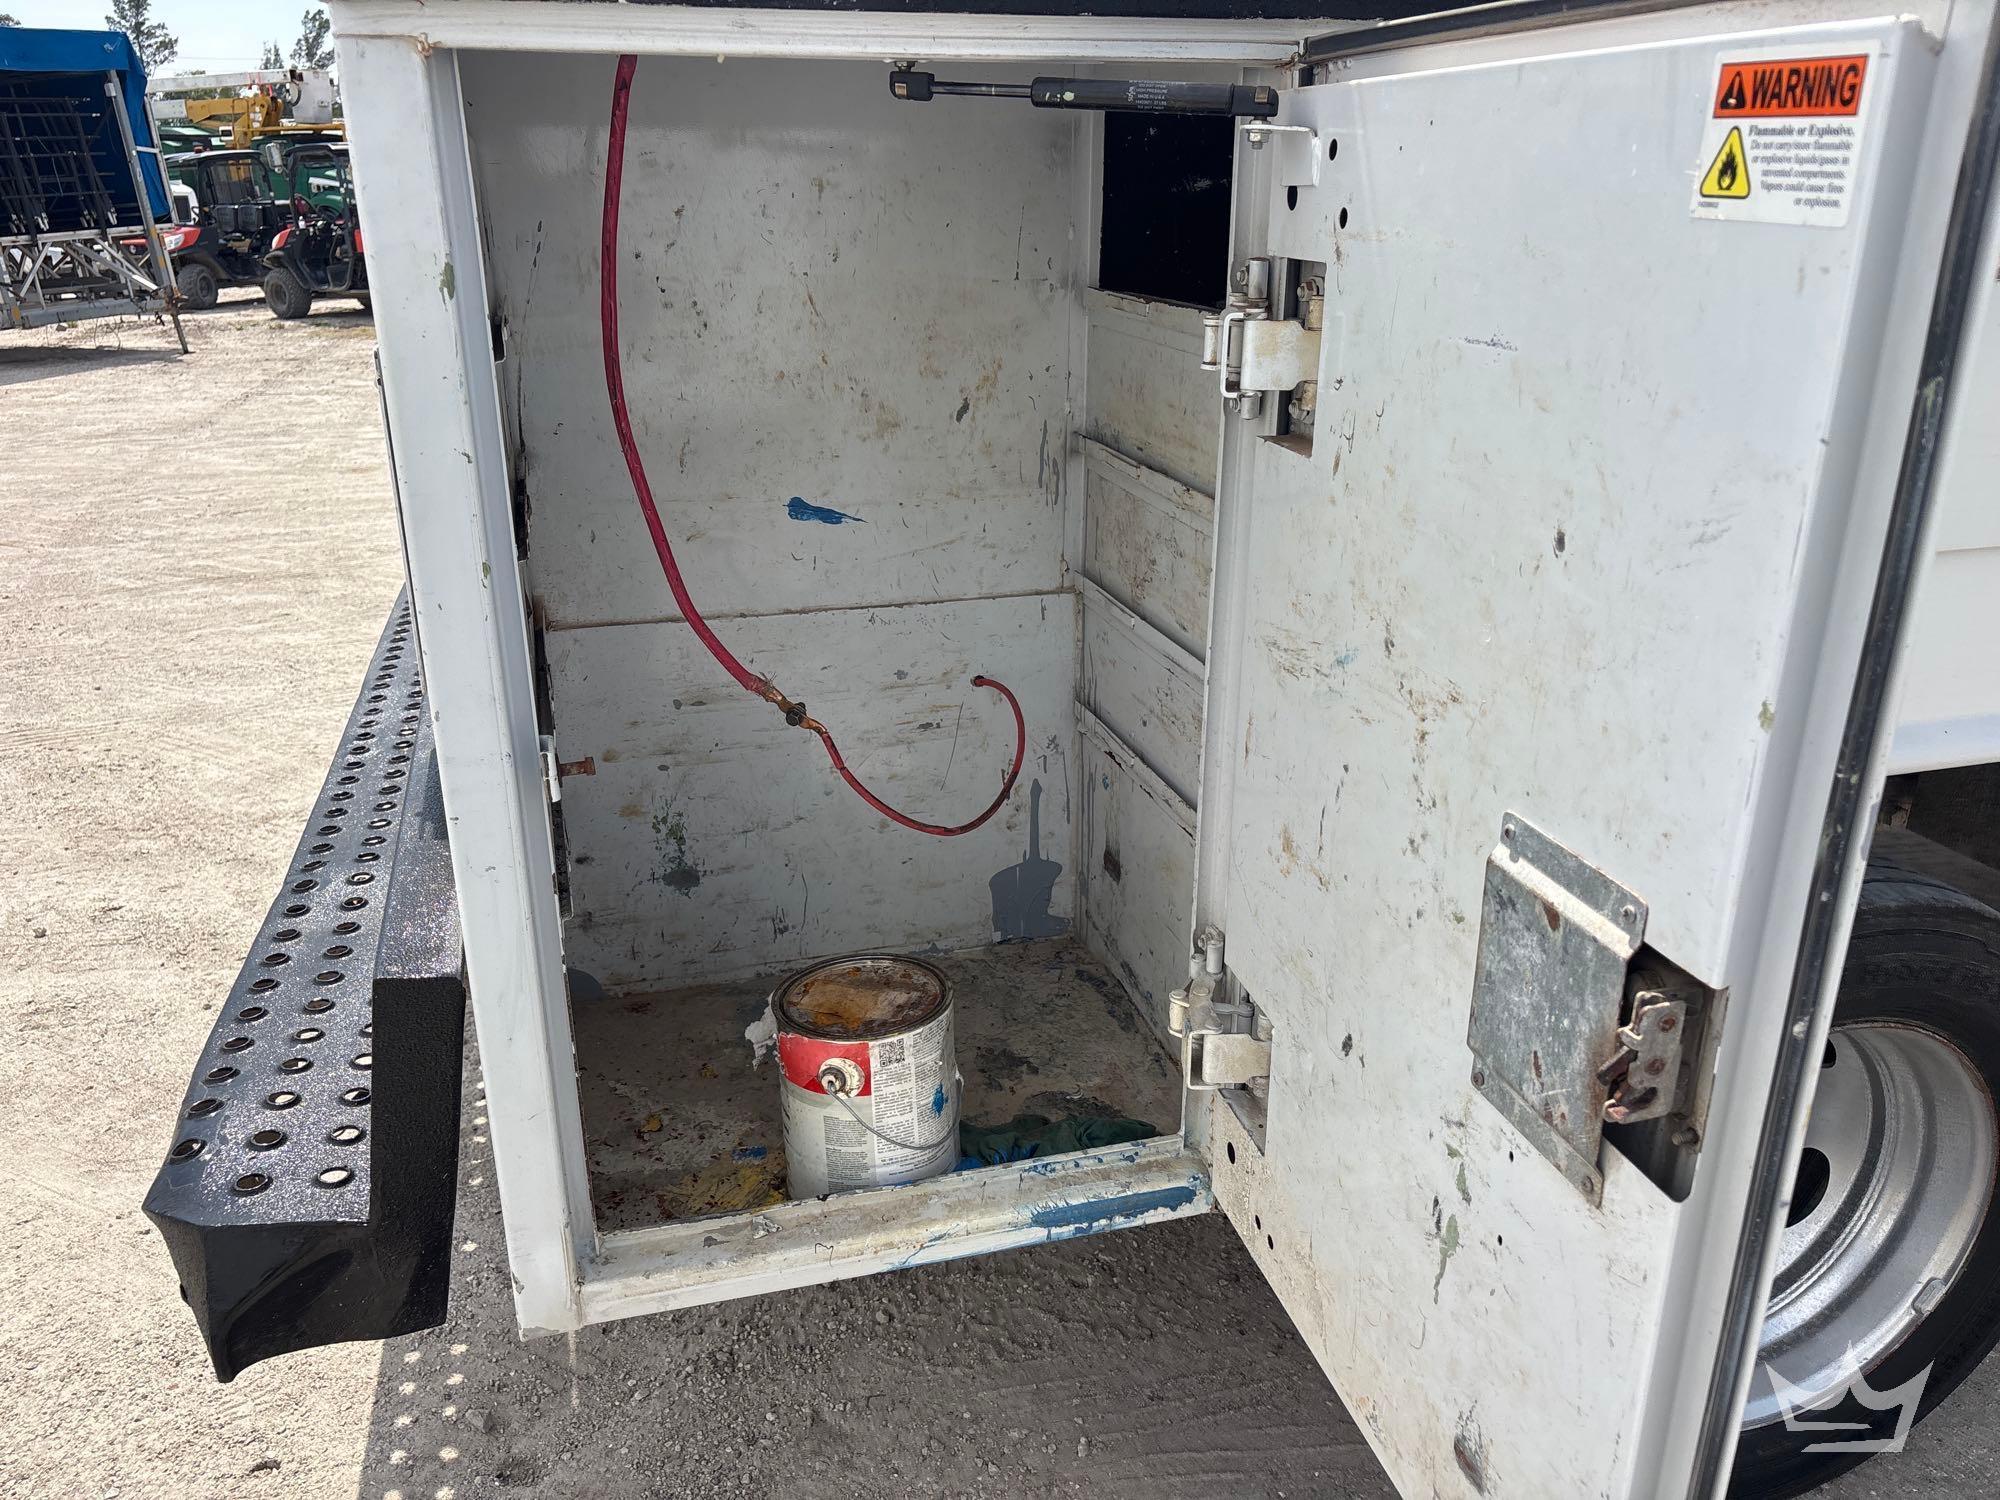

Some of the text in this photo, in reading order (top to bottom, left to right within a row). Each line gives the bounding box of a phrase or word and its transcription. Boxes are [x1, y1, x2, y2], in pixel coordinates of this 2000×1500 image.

[1752, 64, 1859, 108] WARNING
[1748, 124, 1794, 136] Flammable
[1797, 128, 1806, 136] or
